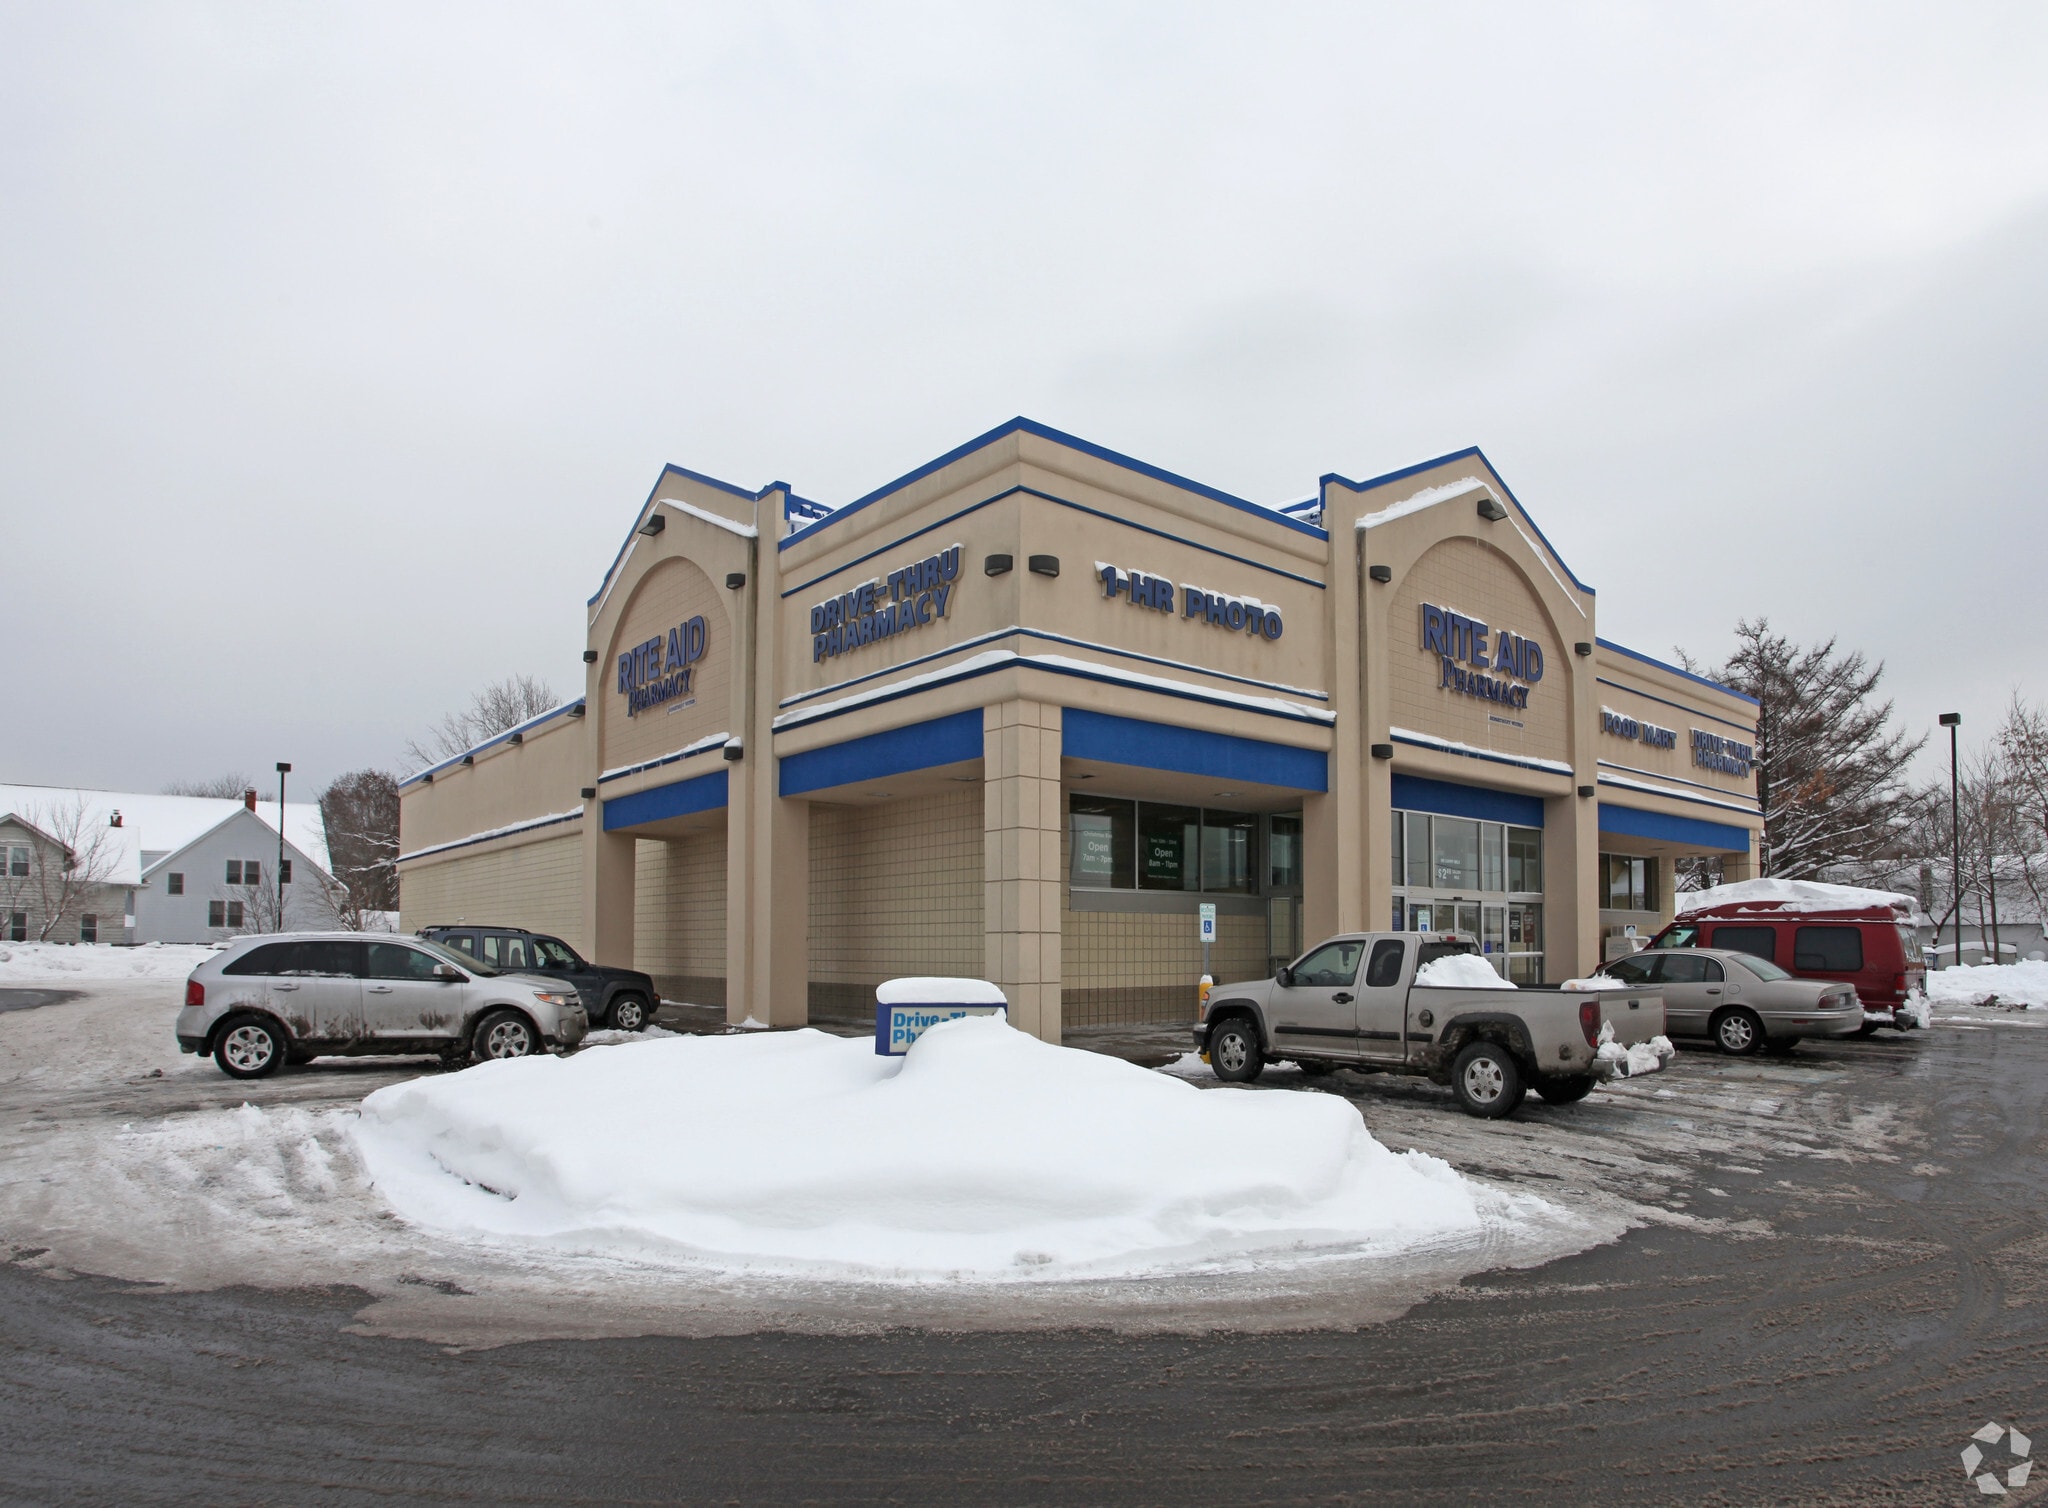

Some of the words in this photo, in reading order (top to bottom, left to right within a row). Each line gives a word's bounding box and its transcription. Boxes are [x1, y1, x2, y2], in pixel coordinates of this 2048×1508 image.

[811, 546, 960, 635] DRIVE-THRU
[1100, 565, 1175, 614] 1-HR
[1185, 587, 1284, 641] PHOTO
[813, 585, 951, 664] PHARMACY
[1422, 602, 1490, 669] RITE
[1494, 630, 1544, 683] AID
[617, 635, 661, 695] RITE
[664, 614, 705, 674] AID
[626, 667, 692, 718] PHARMACY
[1441, 655, 1530, 709] PHARMACY
[1603, 711, 1640, 740] FOOD
[1642, 722, 1678, 750] MART
[1693, 729, 1753, 762] DRIVE-THRU
[1695, 748, 1751, 779] PHARMACY
[1088, 841, 1109, 853] Open
[1154, 847, 1173, 859] Open
